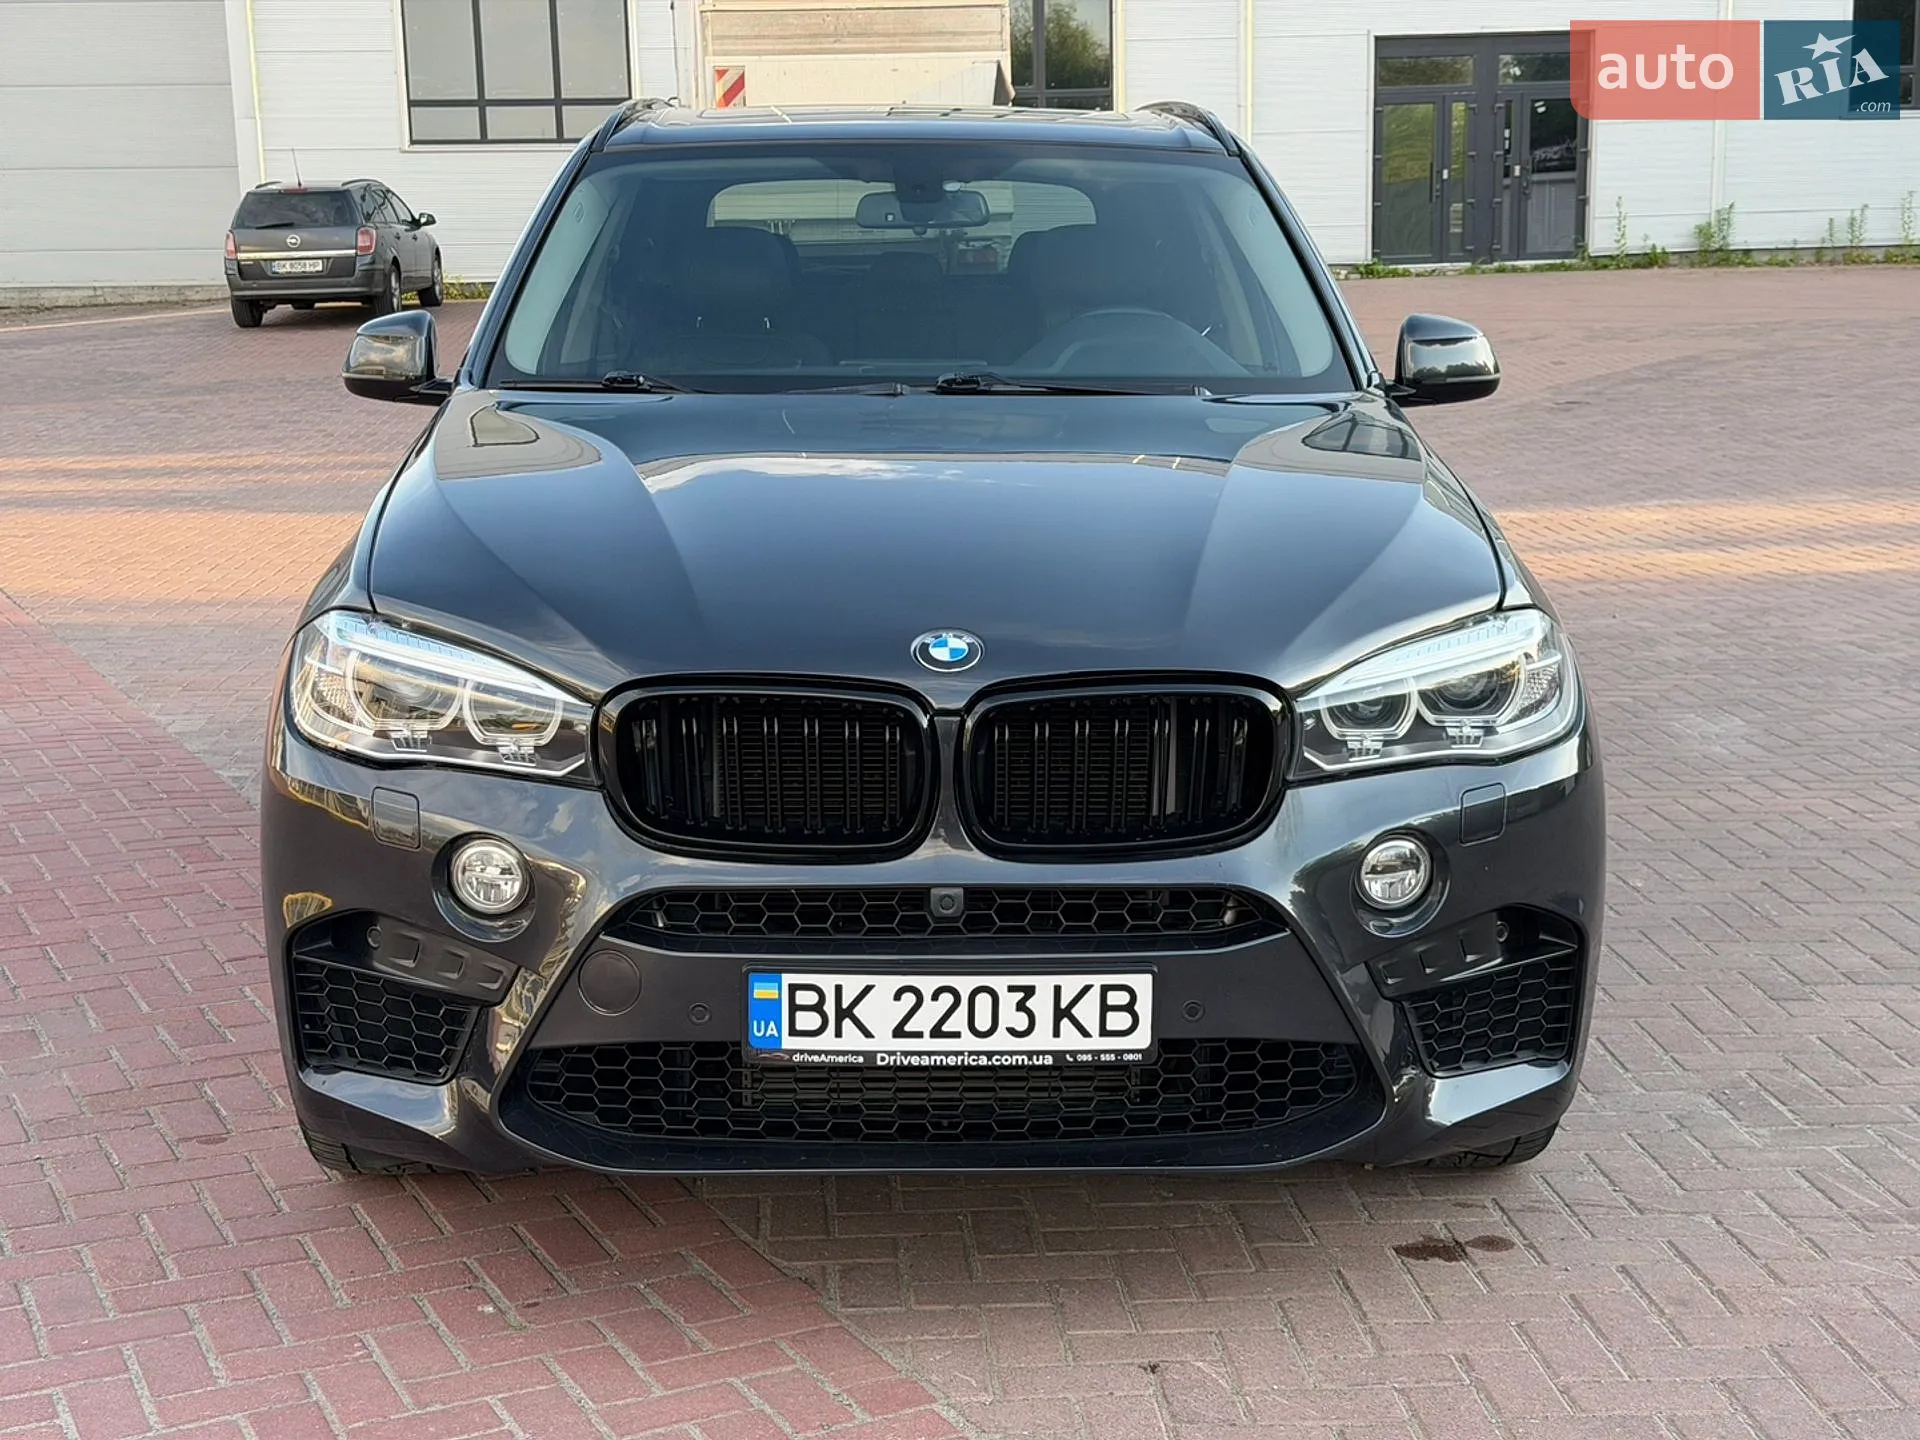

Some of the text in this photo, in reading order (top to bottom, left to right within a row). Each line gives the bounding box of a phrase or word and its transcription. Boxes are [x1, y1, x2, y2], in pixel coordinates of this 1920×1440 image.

[787, 983, 1140, 1040] BK 2203 KB
[753, 1020, 778, 1038] UA
[792, 1052, 864, 1064] driveAmerica
[876, 1051, 1053, 1066] Driveamerica.com.ua
